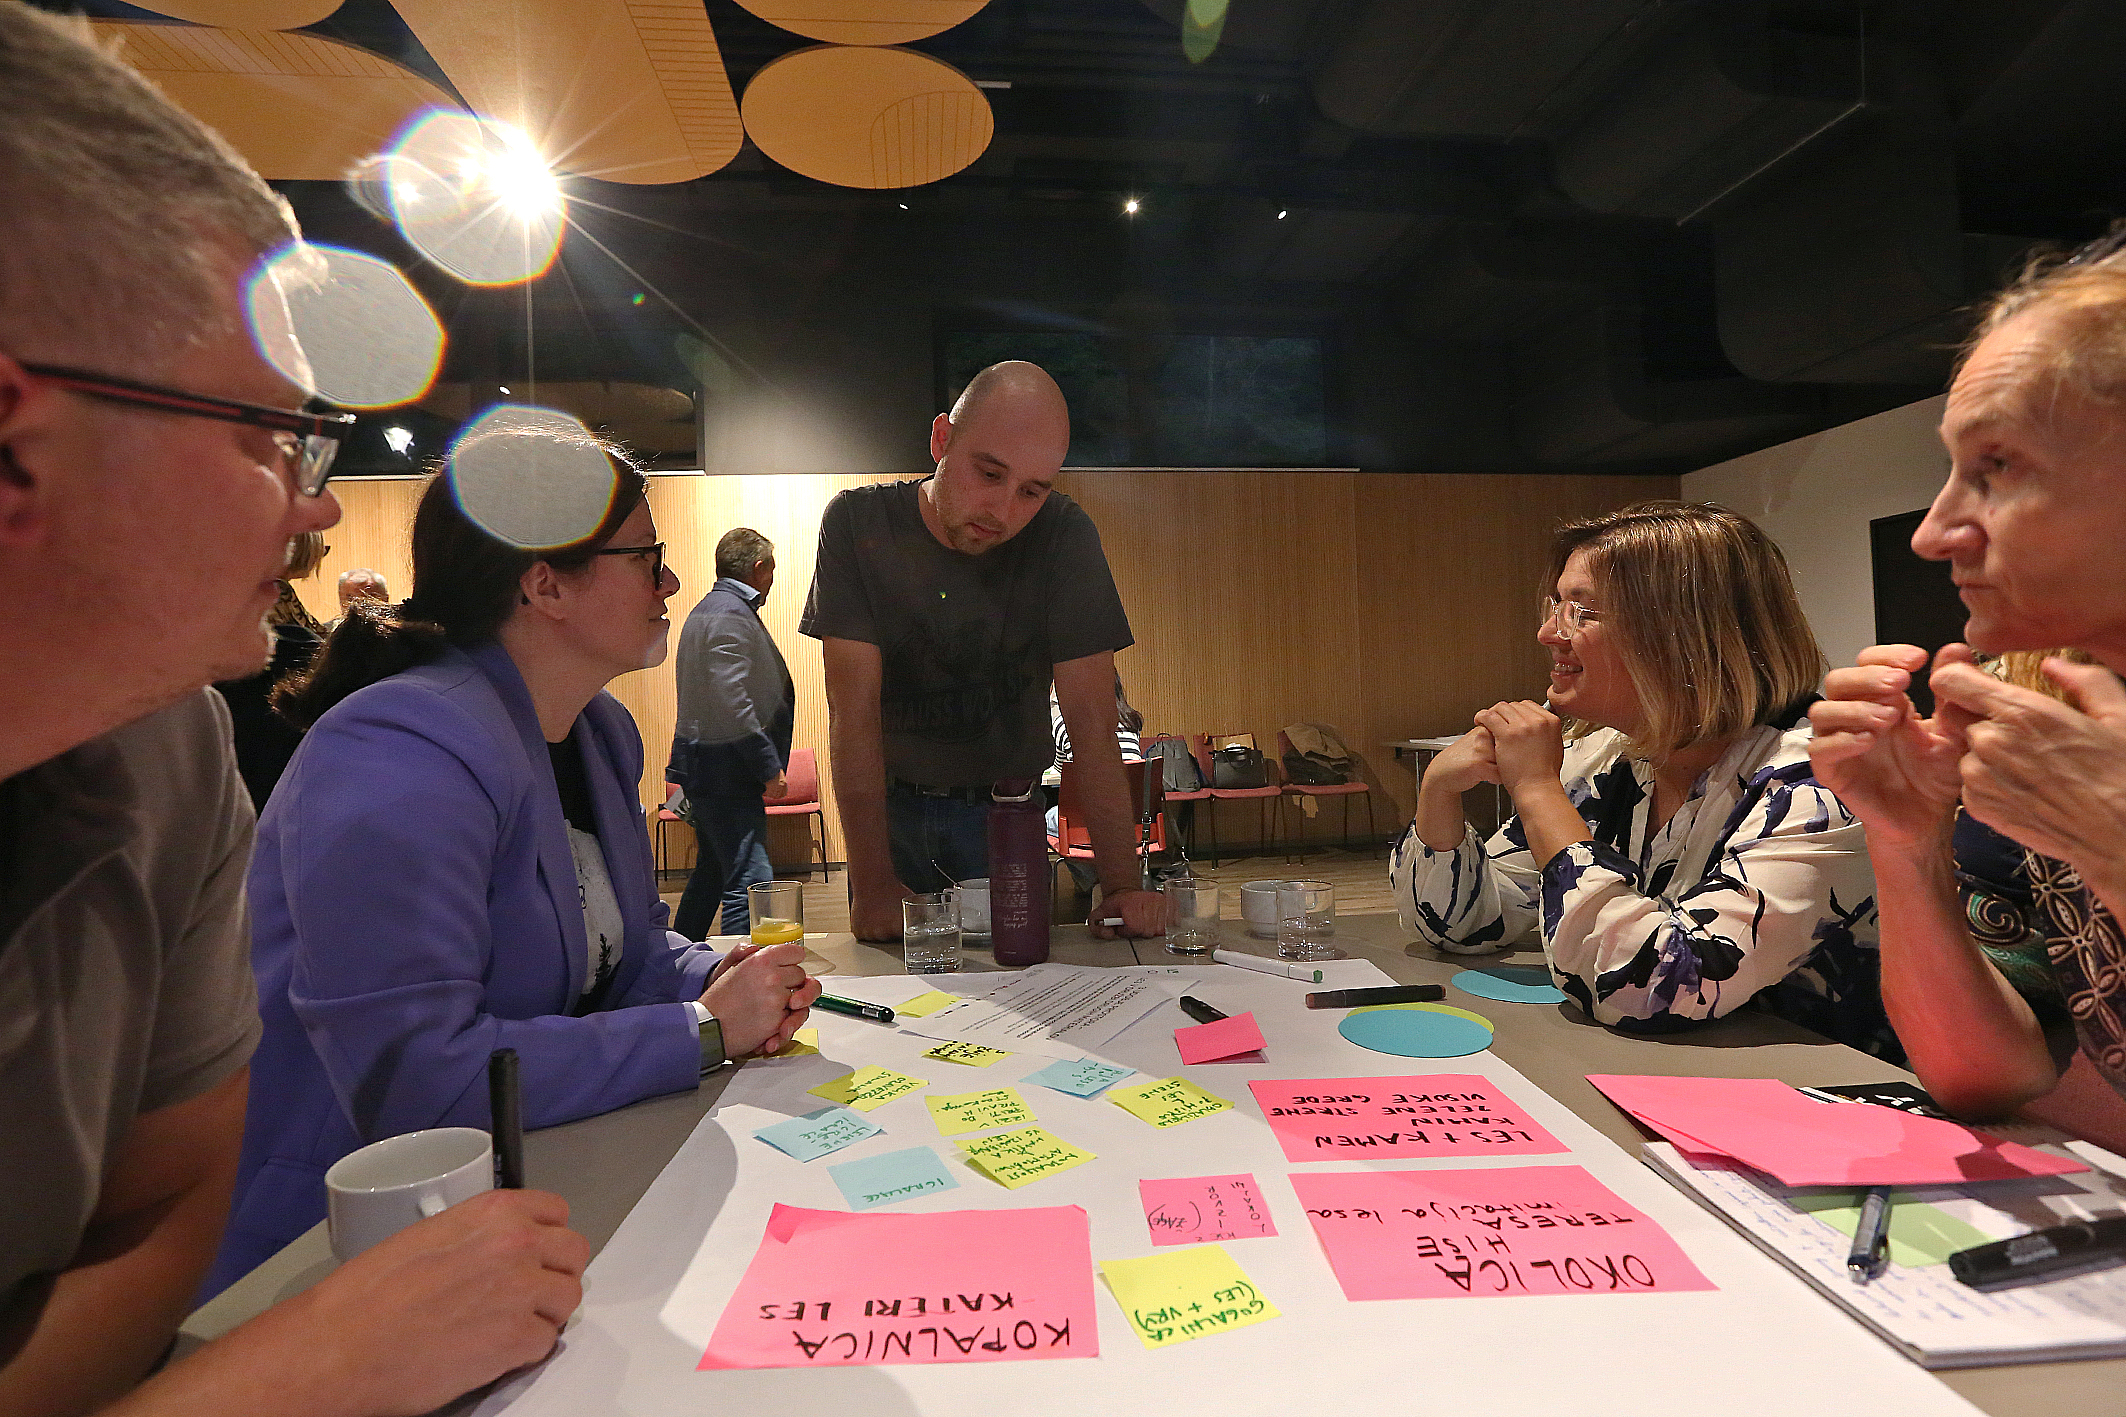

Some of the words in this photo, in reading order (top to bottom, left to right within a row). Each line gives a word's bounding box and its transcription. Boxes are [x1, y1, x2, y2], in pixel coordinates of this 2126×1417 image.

[1139, 1080, 1181, 1100] STENE
[1392, 1093, 1486, 1104] VISOKE
[1291, 1095, 1371, 1105] GREDE
[1381, 1106, 1491, 1115] ZELENE
[1410, 1117, 1515, 1127] KAMIN
[1315, 1131, 1431, 1148] KAMEN
[1442, 1132, 1460, 1144] +
[1469, 1130, 1533, 1144] LES
[1305, 1208, 1383, 1223] lesa
[1472, 1212, 1633, 1230] TERESA
[1435, 1255, 1655, 1292] OKOLICA
[759, 1301, 831, 1321] LES
[864, 1292, 1013, 1317] KATERI
[1147, 1300, 1264, 1342] GUGALNICA
[792, 1318, 1070, 1360] KOPALNICA
